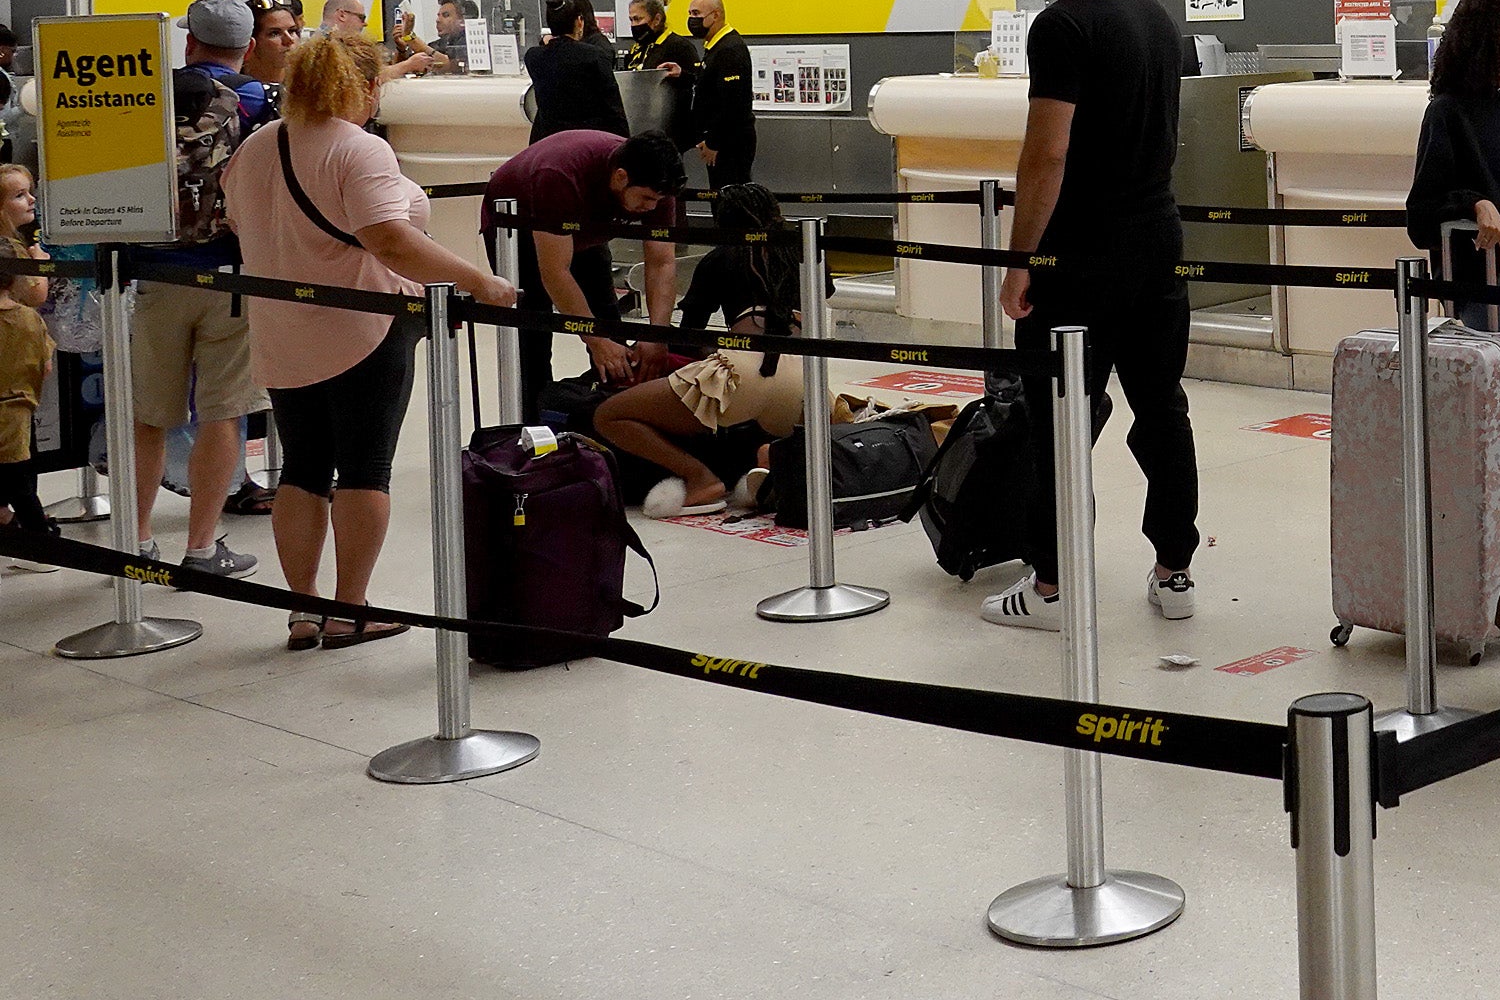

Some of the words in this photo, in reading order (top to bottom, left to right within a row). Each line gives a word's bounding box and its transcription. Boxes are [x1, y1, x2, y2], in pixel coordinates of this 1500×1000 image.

[52, 48, 153, 87] Agent
[56, 89, 156, 109] Assistance
[911, 192, 935, 203] spirit
[1208, 210, 1232, 221] spirit
[1342, 212, 1368, 224] spirit
[562, 221, 581, 233] spirit
[651, 228, 670, 239] spirit
[744, 231, 768, 243] spirit
[896, 243, 923, 256] spirit
[1028, 254, 1058, 268] spirit
[1174, 262, 1205, 278] spirit
[1335, 269, 1370, 285] spirit
[294, 286, 315, 300] spirit
[564, 318, 595, 335] spirit
[717, 335, 752, 351] spirit
[890, 348, 929, 363] spirit
[122, 563, 173, 587] spirit
[690, 651, 767, 680] spirit
[1075, 711, 1165, 747] spirit
